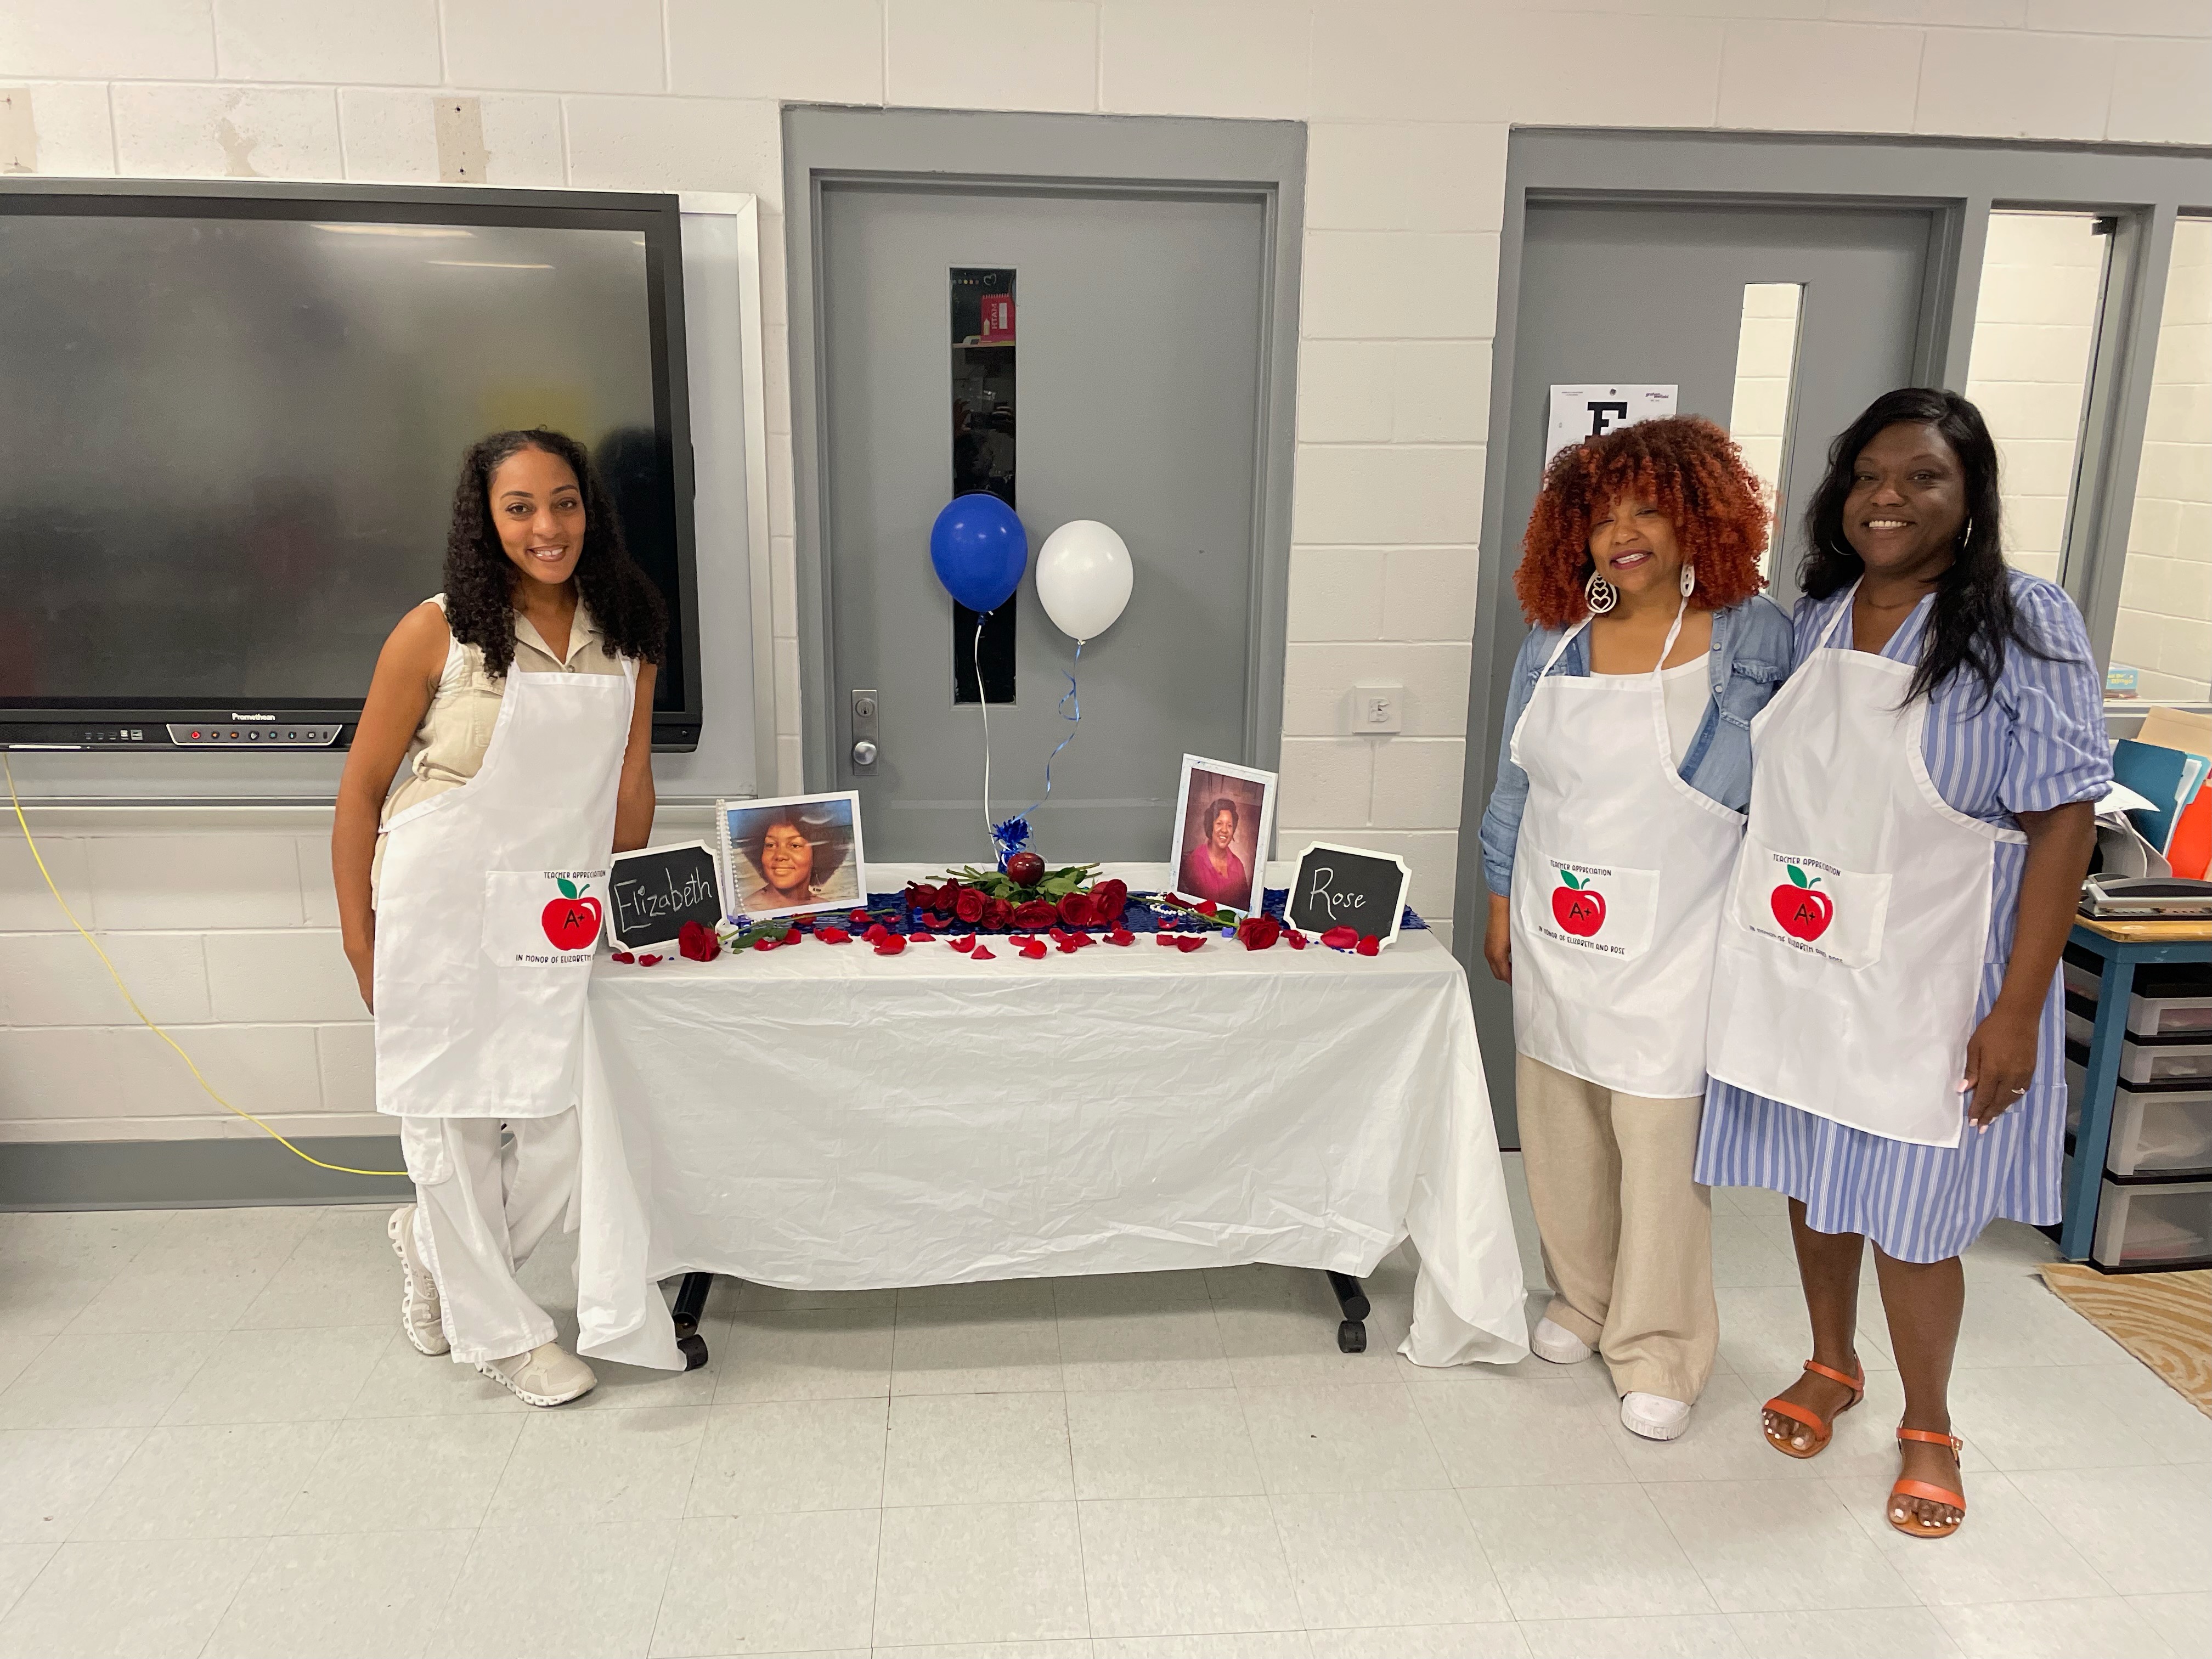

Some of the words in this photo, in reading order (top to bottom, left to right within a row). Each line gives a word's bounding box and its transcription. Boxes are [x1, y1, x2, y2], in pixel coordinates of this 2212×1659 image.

[572, 870, 606, 878] APPRECIATION
[1550, 860, 1570, 870] TEACHER
[1572, 865, 1612, 876] APPRECIATION
[1773, 854, 1801, 864] TEACHER
[1803, 858, 1841, 876] APPRECIATION
[613, 866, 713, 933] Elizabeth
[1309, 867, 1366, 921] Rose
[563, 909, 585, 929] A+
[1569, 902, 1592, 922] A+
[1793, 903, 1816, 926] A+
[1567, 936, 1594, 949] ELIZABETH
[1595, 943, 1609, 951] AND
[1611, 946, 1625, 955] ROSE
[526, 955, 549, 963] HONOR
[561, 954, 591, 963] ELIZABETH
